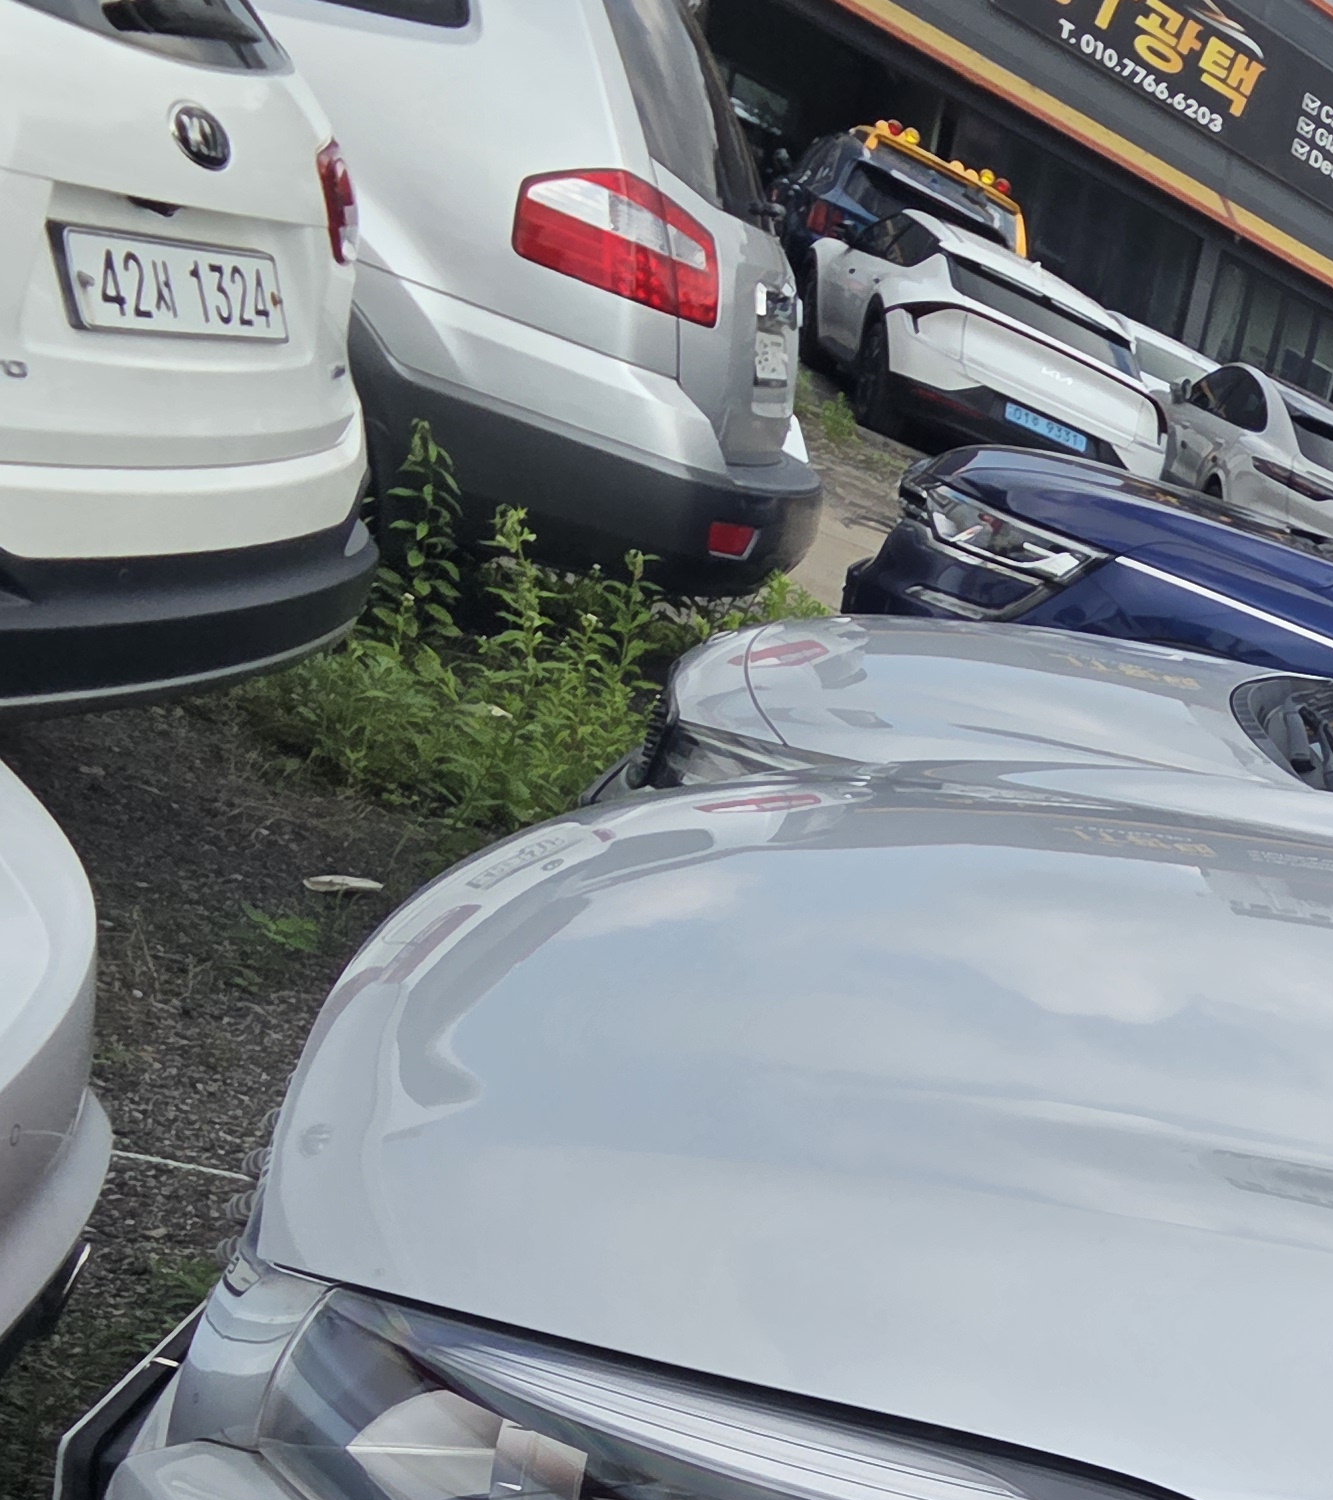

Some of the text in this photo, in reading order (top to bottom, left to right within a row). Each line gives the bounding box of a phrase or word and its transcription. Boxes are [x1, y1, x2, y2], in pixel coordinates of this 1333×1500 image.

[1056, 0, 1267, 117] 광택
[1080, 33, 1224, 133] 010.7766.6203
[101, 248, 272, 329] 42서 1324
